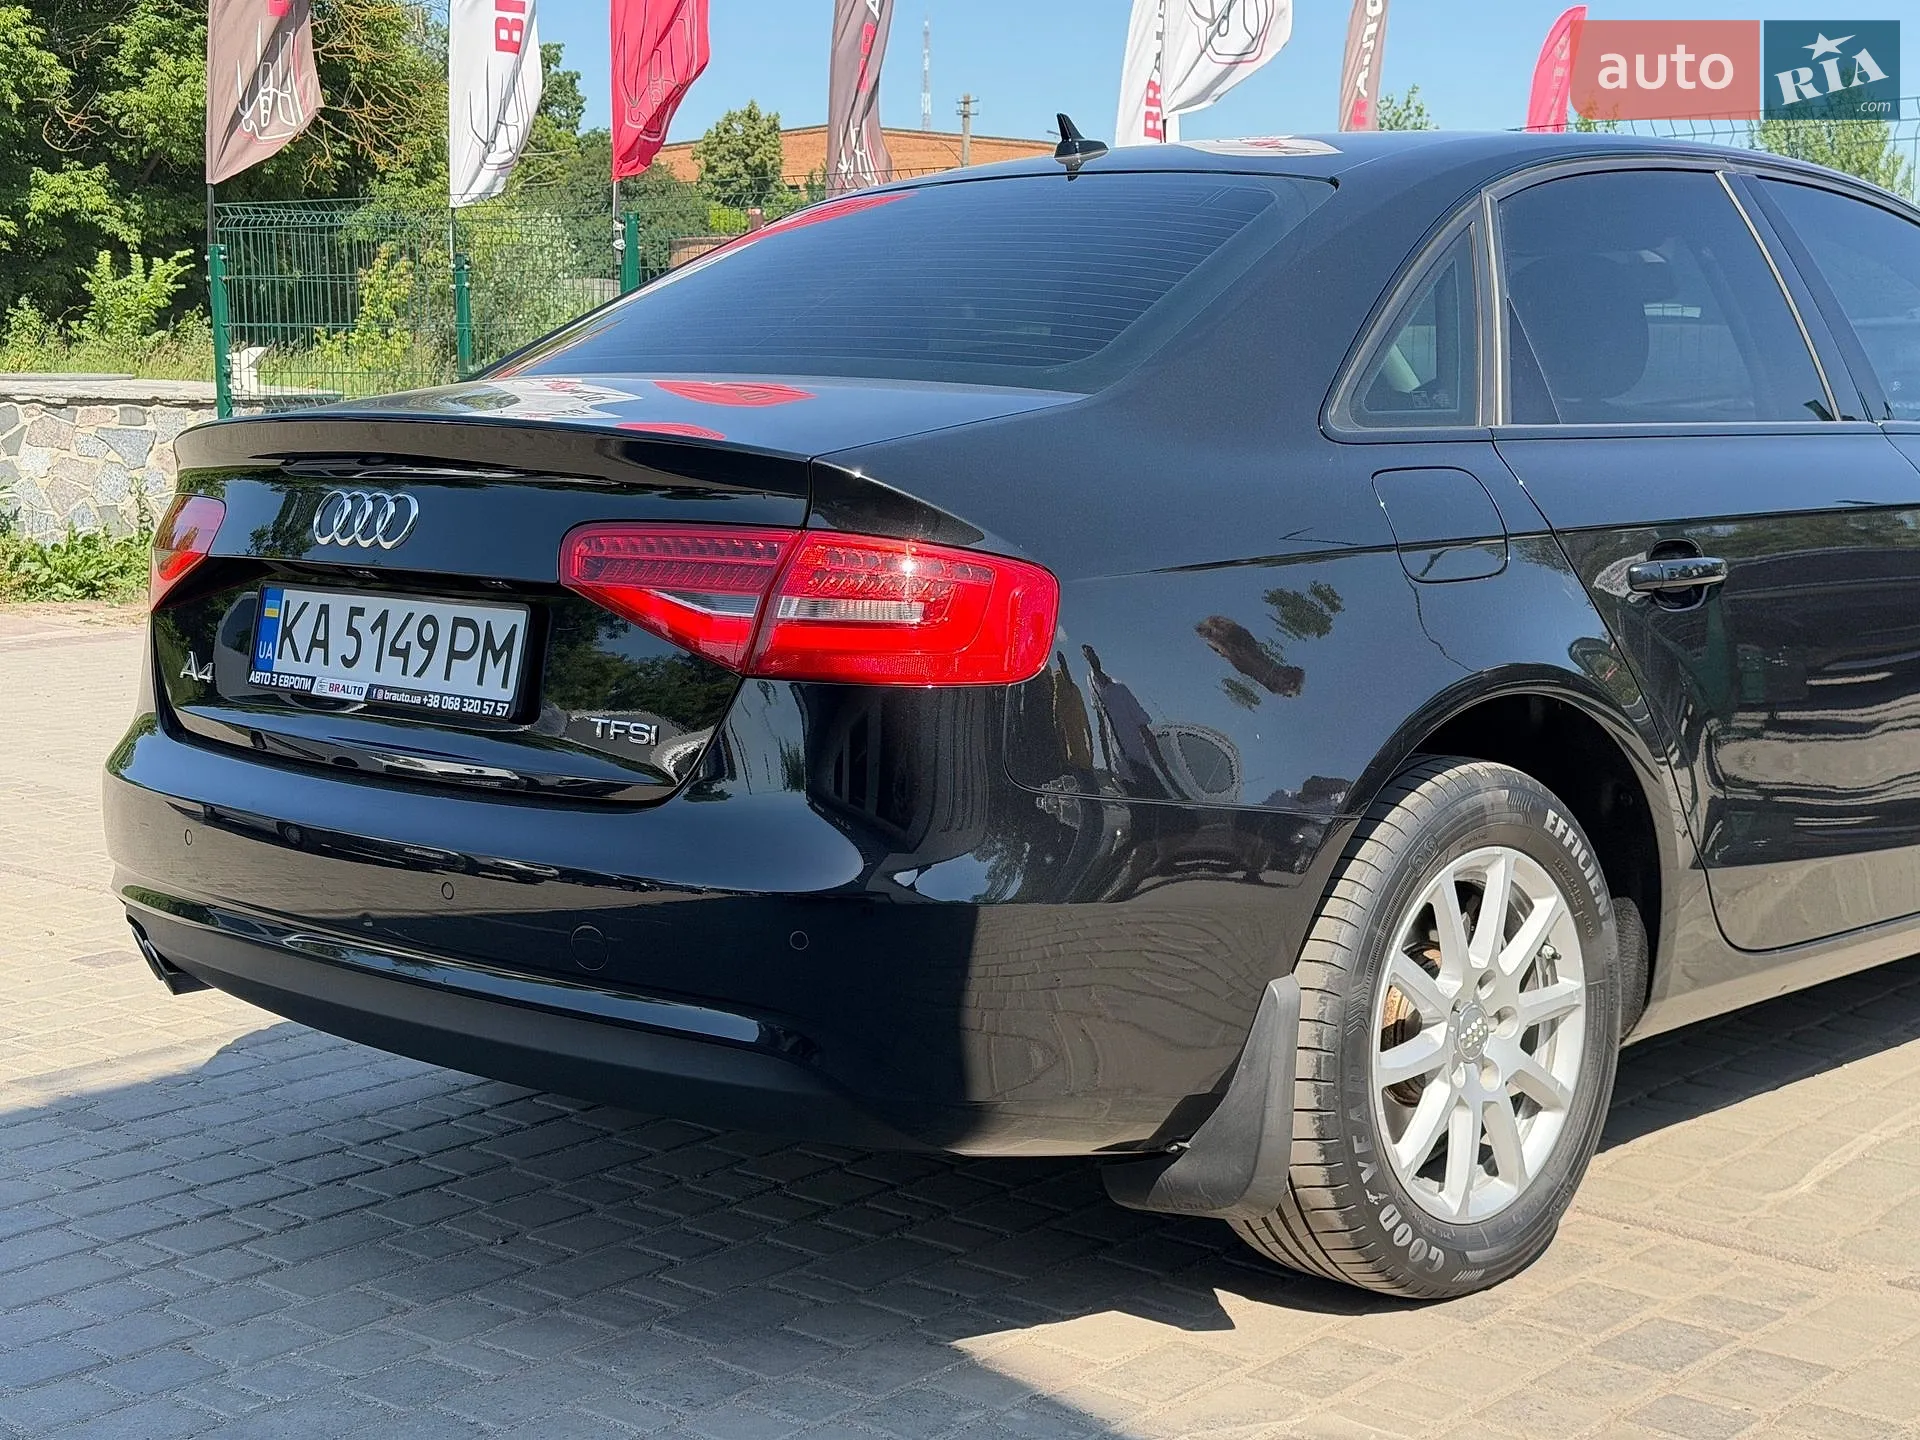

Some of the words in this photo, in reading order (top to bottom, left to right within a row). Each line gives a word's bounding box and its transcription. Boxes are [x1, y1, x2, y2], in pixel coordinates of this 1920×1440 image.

[258, 641, 273, 660] UA
[277, 599, 330, 667] KA
[340, 606, 440, 679] 5149
[443, 616, 518, 690] PM
[179, 651, 213, 683] A4
[328, 683, 364, 696] BRAUTO
[384, 690, 421, 704] brauto.ua
[423, 693, 440, 709] +38
[441, 696, 460, 711] 068
[461, 698, 480, 713] 320
[482, 701, 495, 716] 57
[495, 703, 510, 717] 57
[590, 717, 657, 746] TFSI
